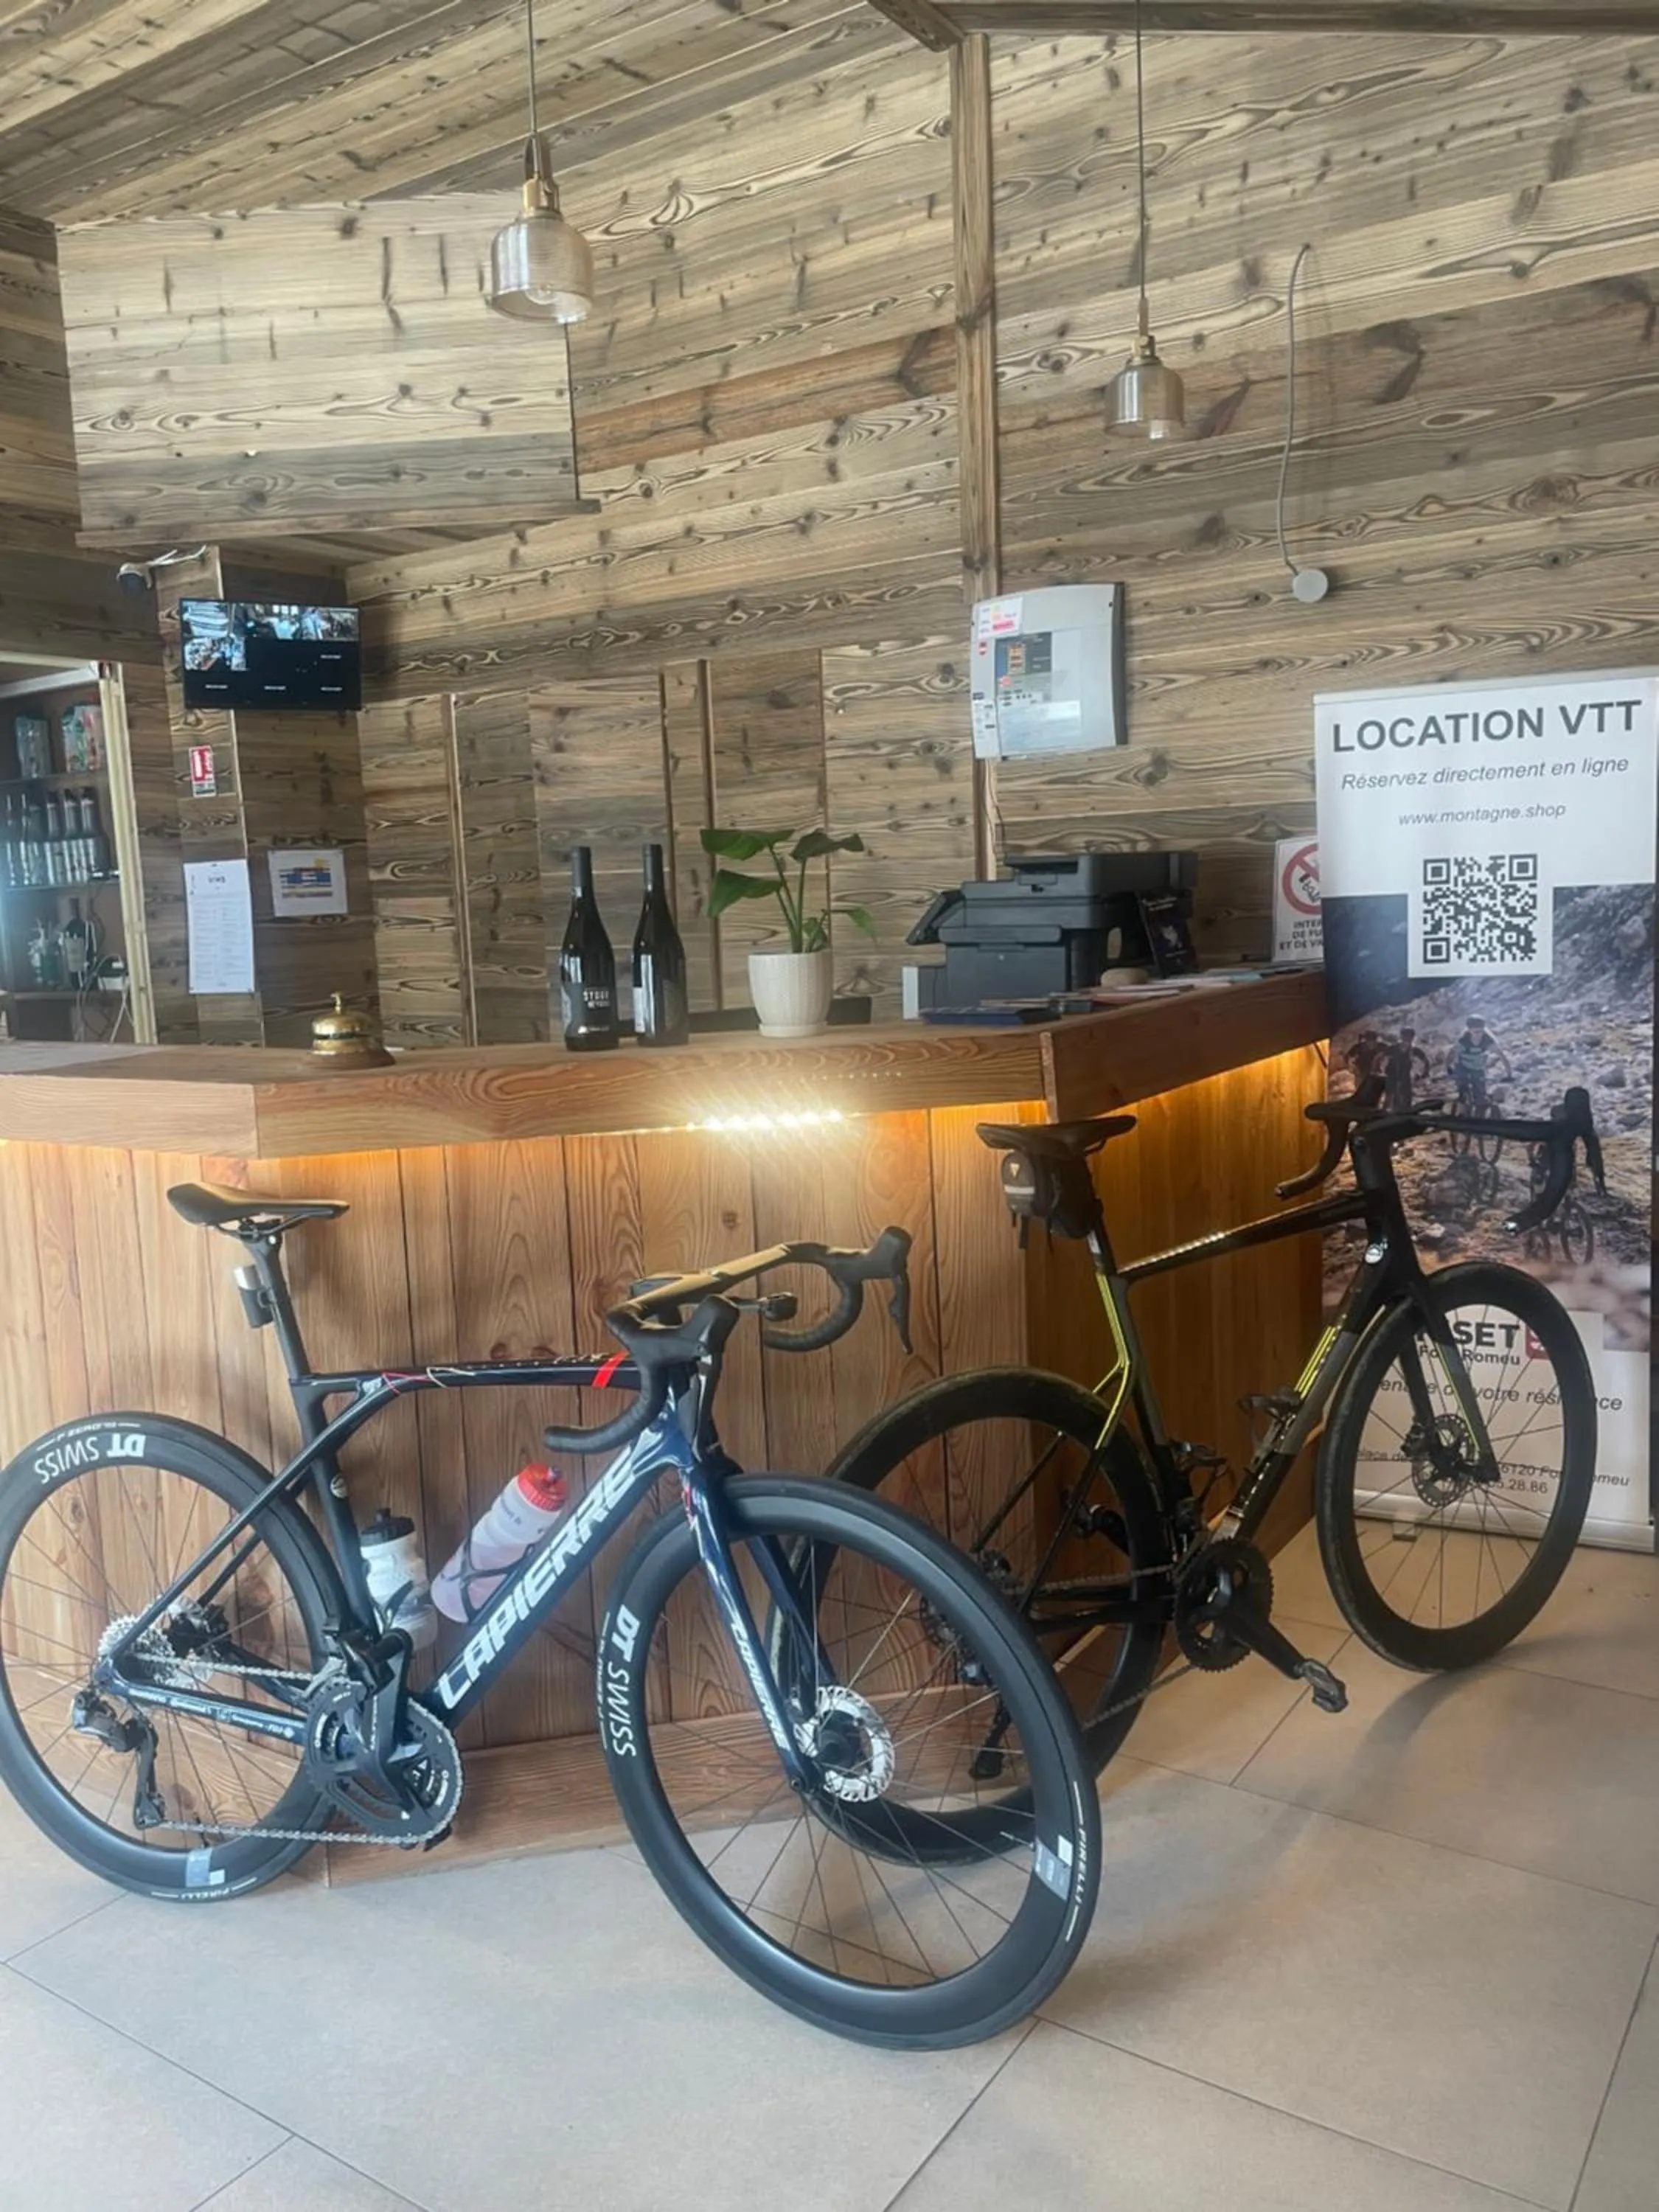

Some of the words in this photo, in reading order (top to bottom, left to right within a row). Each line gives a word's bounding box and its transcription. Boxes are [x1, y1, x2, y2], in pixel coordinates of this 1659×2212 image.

[1332, 707, 1544, 752] LOCATION
[1558, 699, 1642, 735] VTT
[1433, 761, 1545, 784] directement
[1551, 762, 1576, 776] en
[1582, 757, 1629, 778] ligne
[1399, 803, 1566, 826] www.montagne.shop
[1453, 1321, 1520, 1349] SET
[1461, 1349, 1520, 1365] Romeu
[34, 1436, 100, 1484] SWISS
[107, 1433, 146, 1458] DT
[1500, 1464, 1535, 1476] 6120
[434, 1444, 636, 1710] LAPIERRE
[611, 1604, 640, 1662] DT
[607, 1660, 637, 1756] SWISS
[1075, 1828, 1087, 1904] PIRELLI
